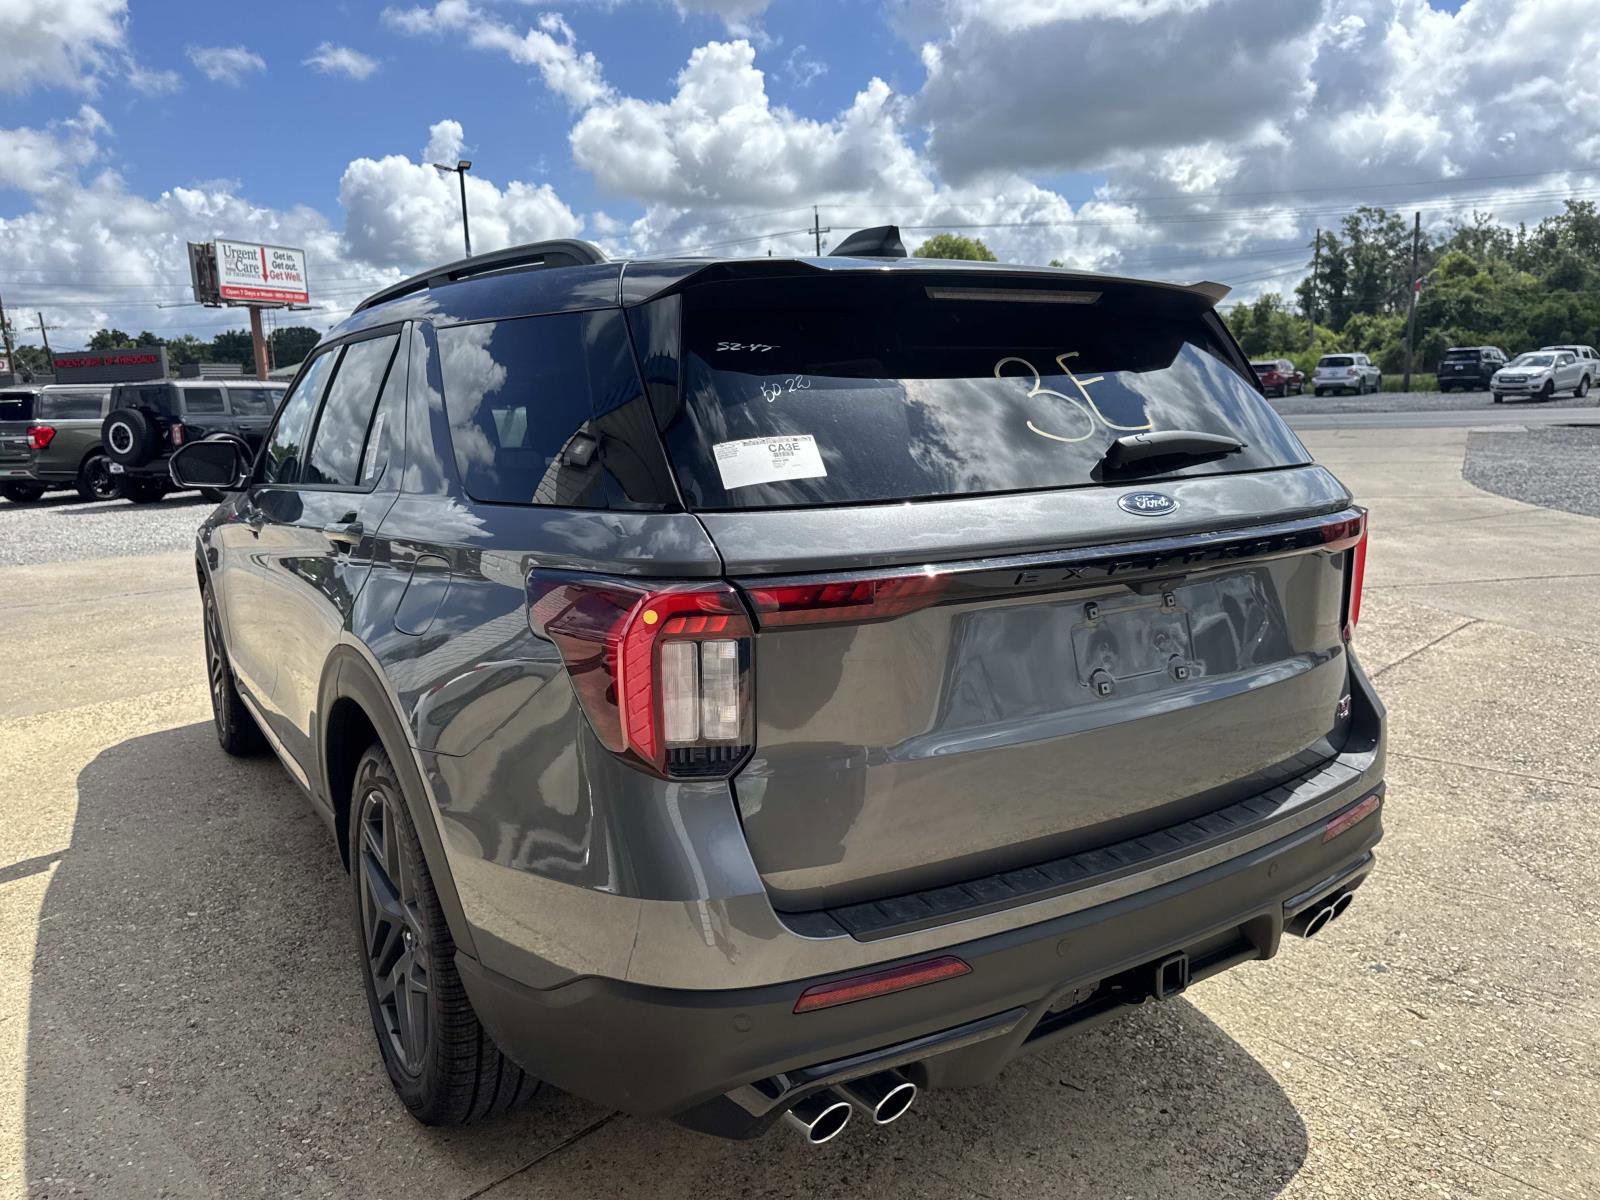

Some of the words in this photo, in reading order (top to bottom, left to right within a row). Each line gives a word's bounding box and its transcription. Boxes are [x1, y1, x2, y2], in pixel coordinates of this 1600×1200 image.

[223, 245, 258, 262] Urgent
[273, 251, 285, 261] Get
[236, 258, 259, 274] Care
[272, 260, 284, 270] Get
[270, 271, 283, 281] Get
[285, 272, 303, 282] Well.
[768, 443, 801, 453] CA3E
[1135, 495, 1168, 509] Ford
